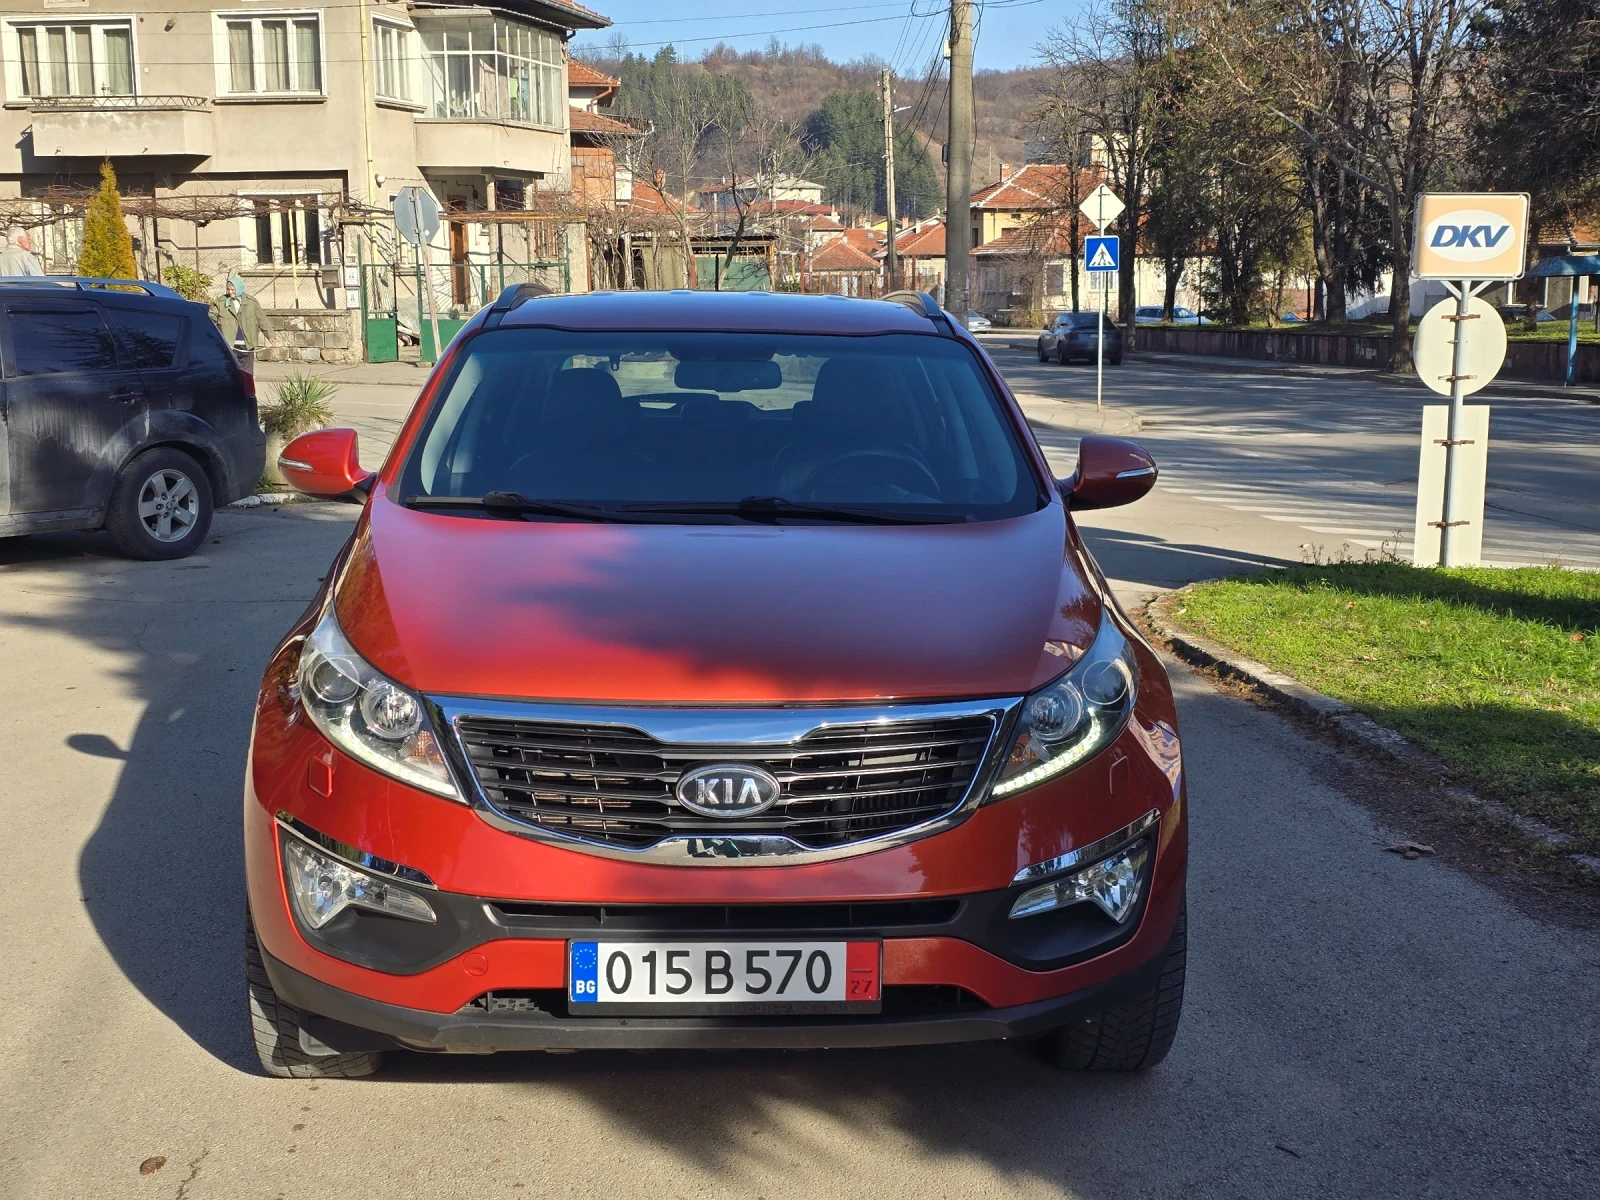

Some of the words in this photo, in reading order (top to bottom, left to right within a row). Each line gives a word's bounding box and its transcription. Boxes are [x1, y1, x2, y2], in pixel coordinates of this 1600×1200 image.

[1430, 225, 1511, 248] DKV
[695, 777, 762, 804] KIA
[576, 979, 596, 994] BG
[851, 979, 873, 995] 27
